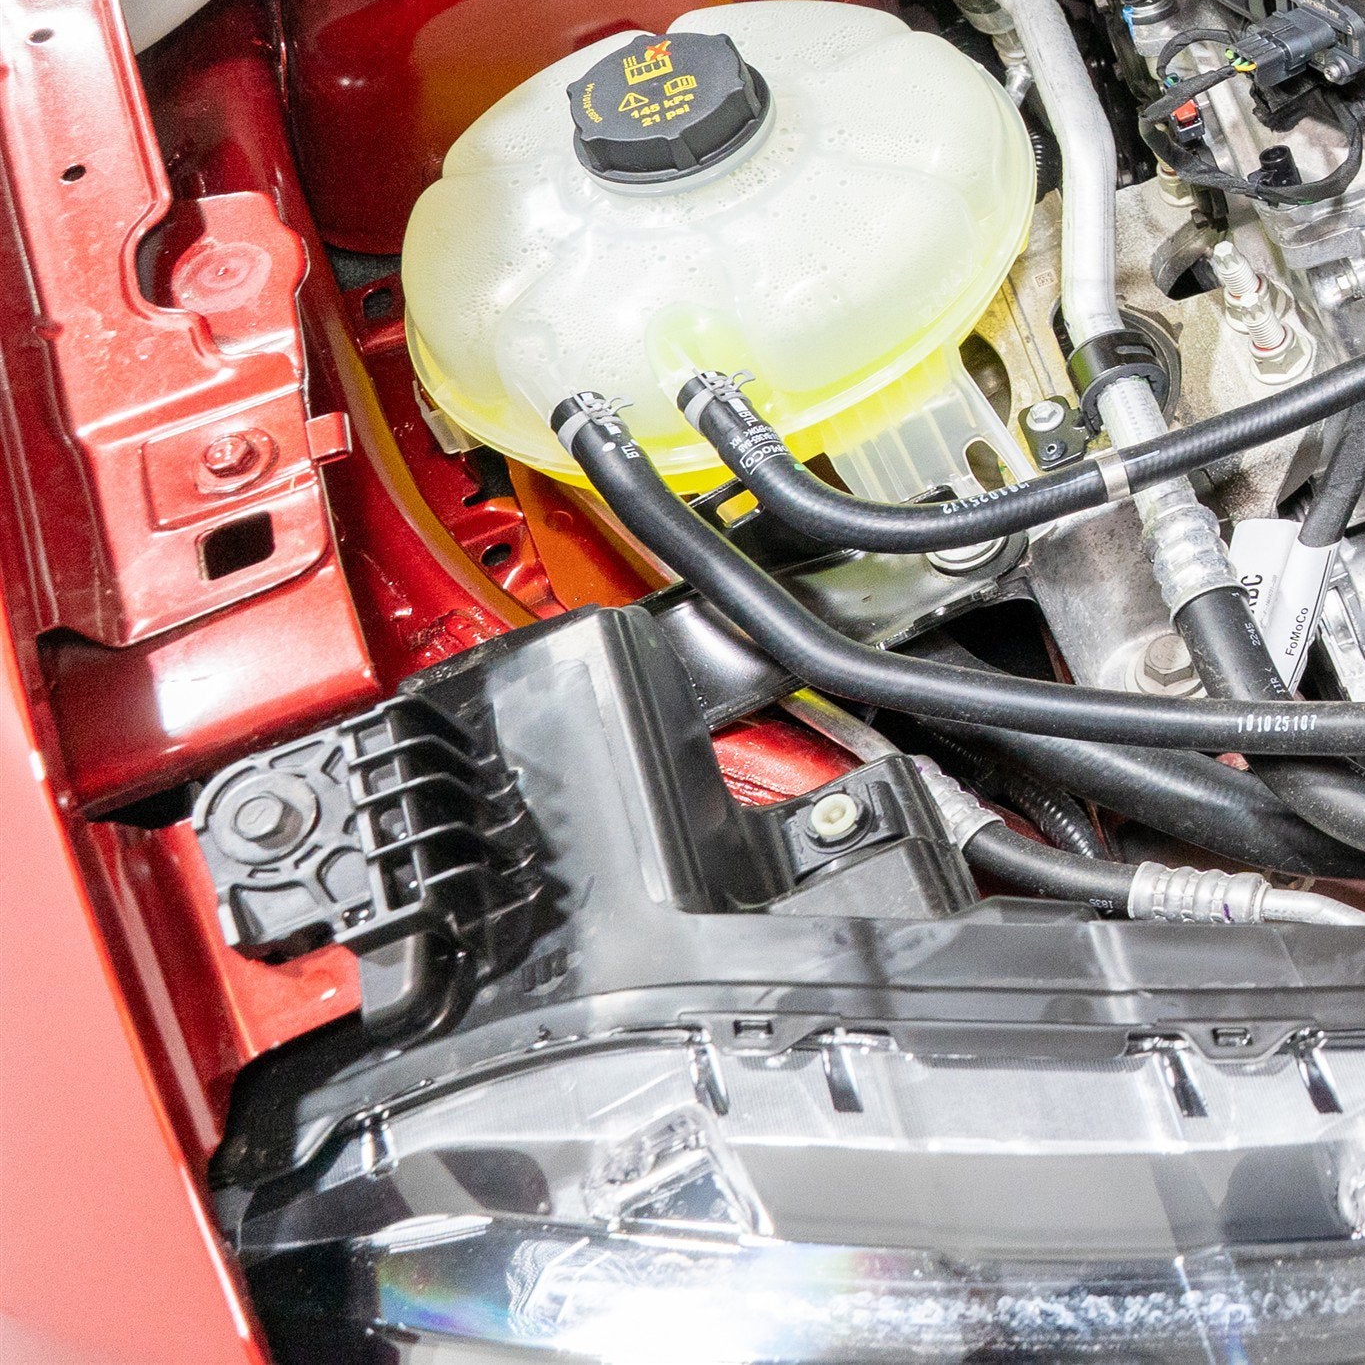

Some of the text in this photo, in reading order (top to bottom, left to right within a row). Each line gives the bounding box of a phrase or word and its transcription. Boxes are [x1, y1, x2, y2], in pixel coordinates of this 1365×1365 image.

[631, 93, 695, 118] 145 kPa
[642, 104, 690, 127] 21 psi
[745, 445, 789, 468] oMoCo
[1285, 607, 1309, 657] FoMoCo
